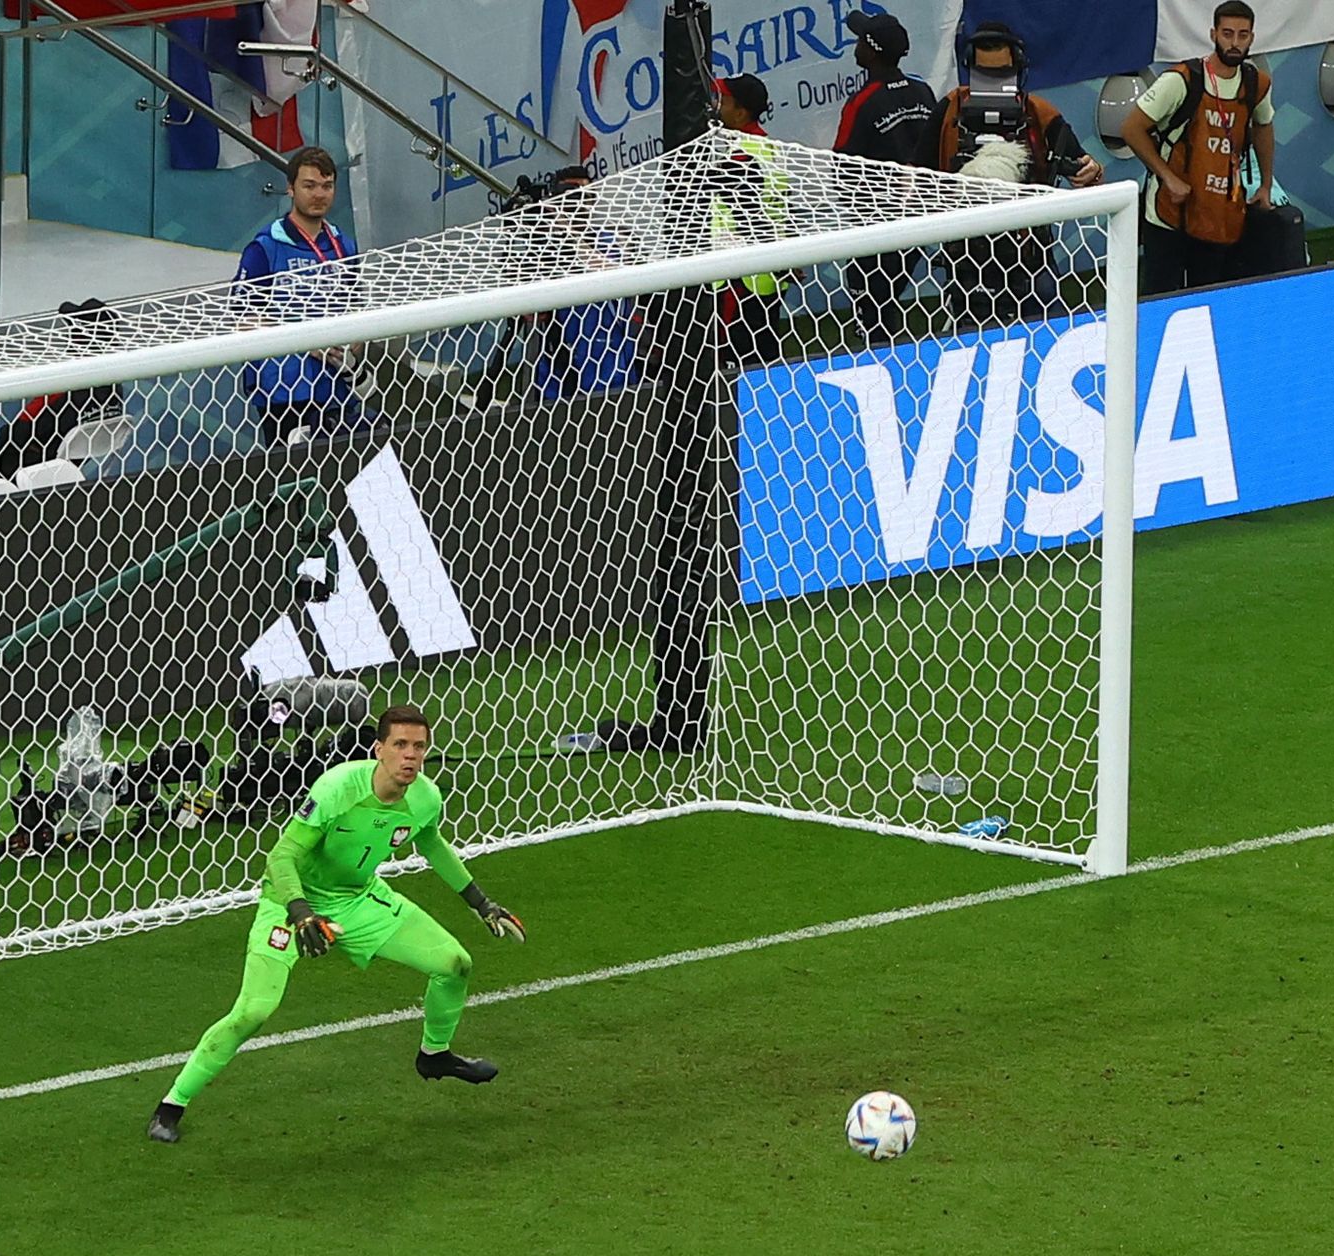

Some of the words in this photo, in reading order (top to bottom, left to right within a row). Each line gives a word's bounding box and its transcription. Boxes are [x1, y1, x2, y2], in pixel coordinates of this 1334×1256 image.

[430, 92, 538, 201] LES
[578, 0, 887, 135] COSAIRE
[587, 152, 608, 180] de
[612, 132, 666, 172] l'Équip
[815, 305, 1239, 564] VISA
